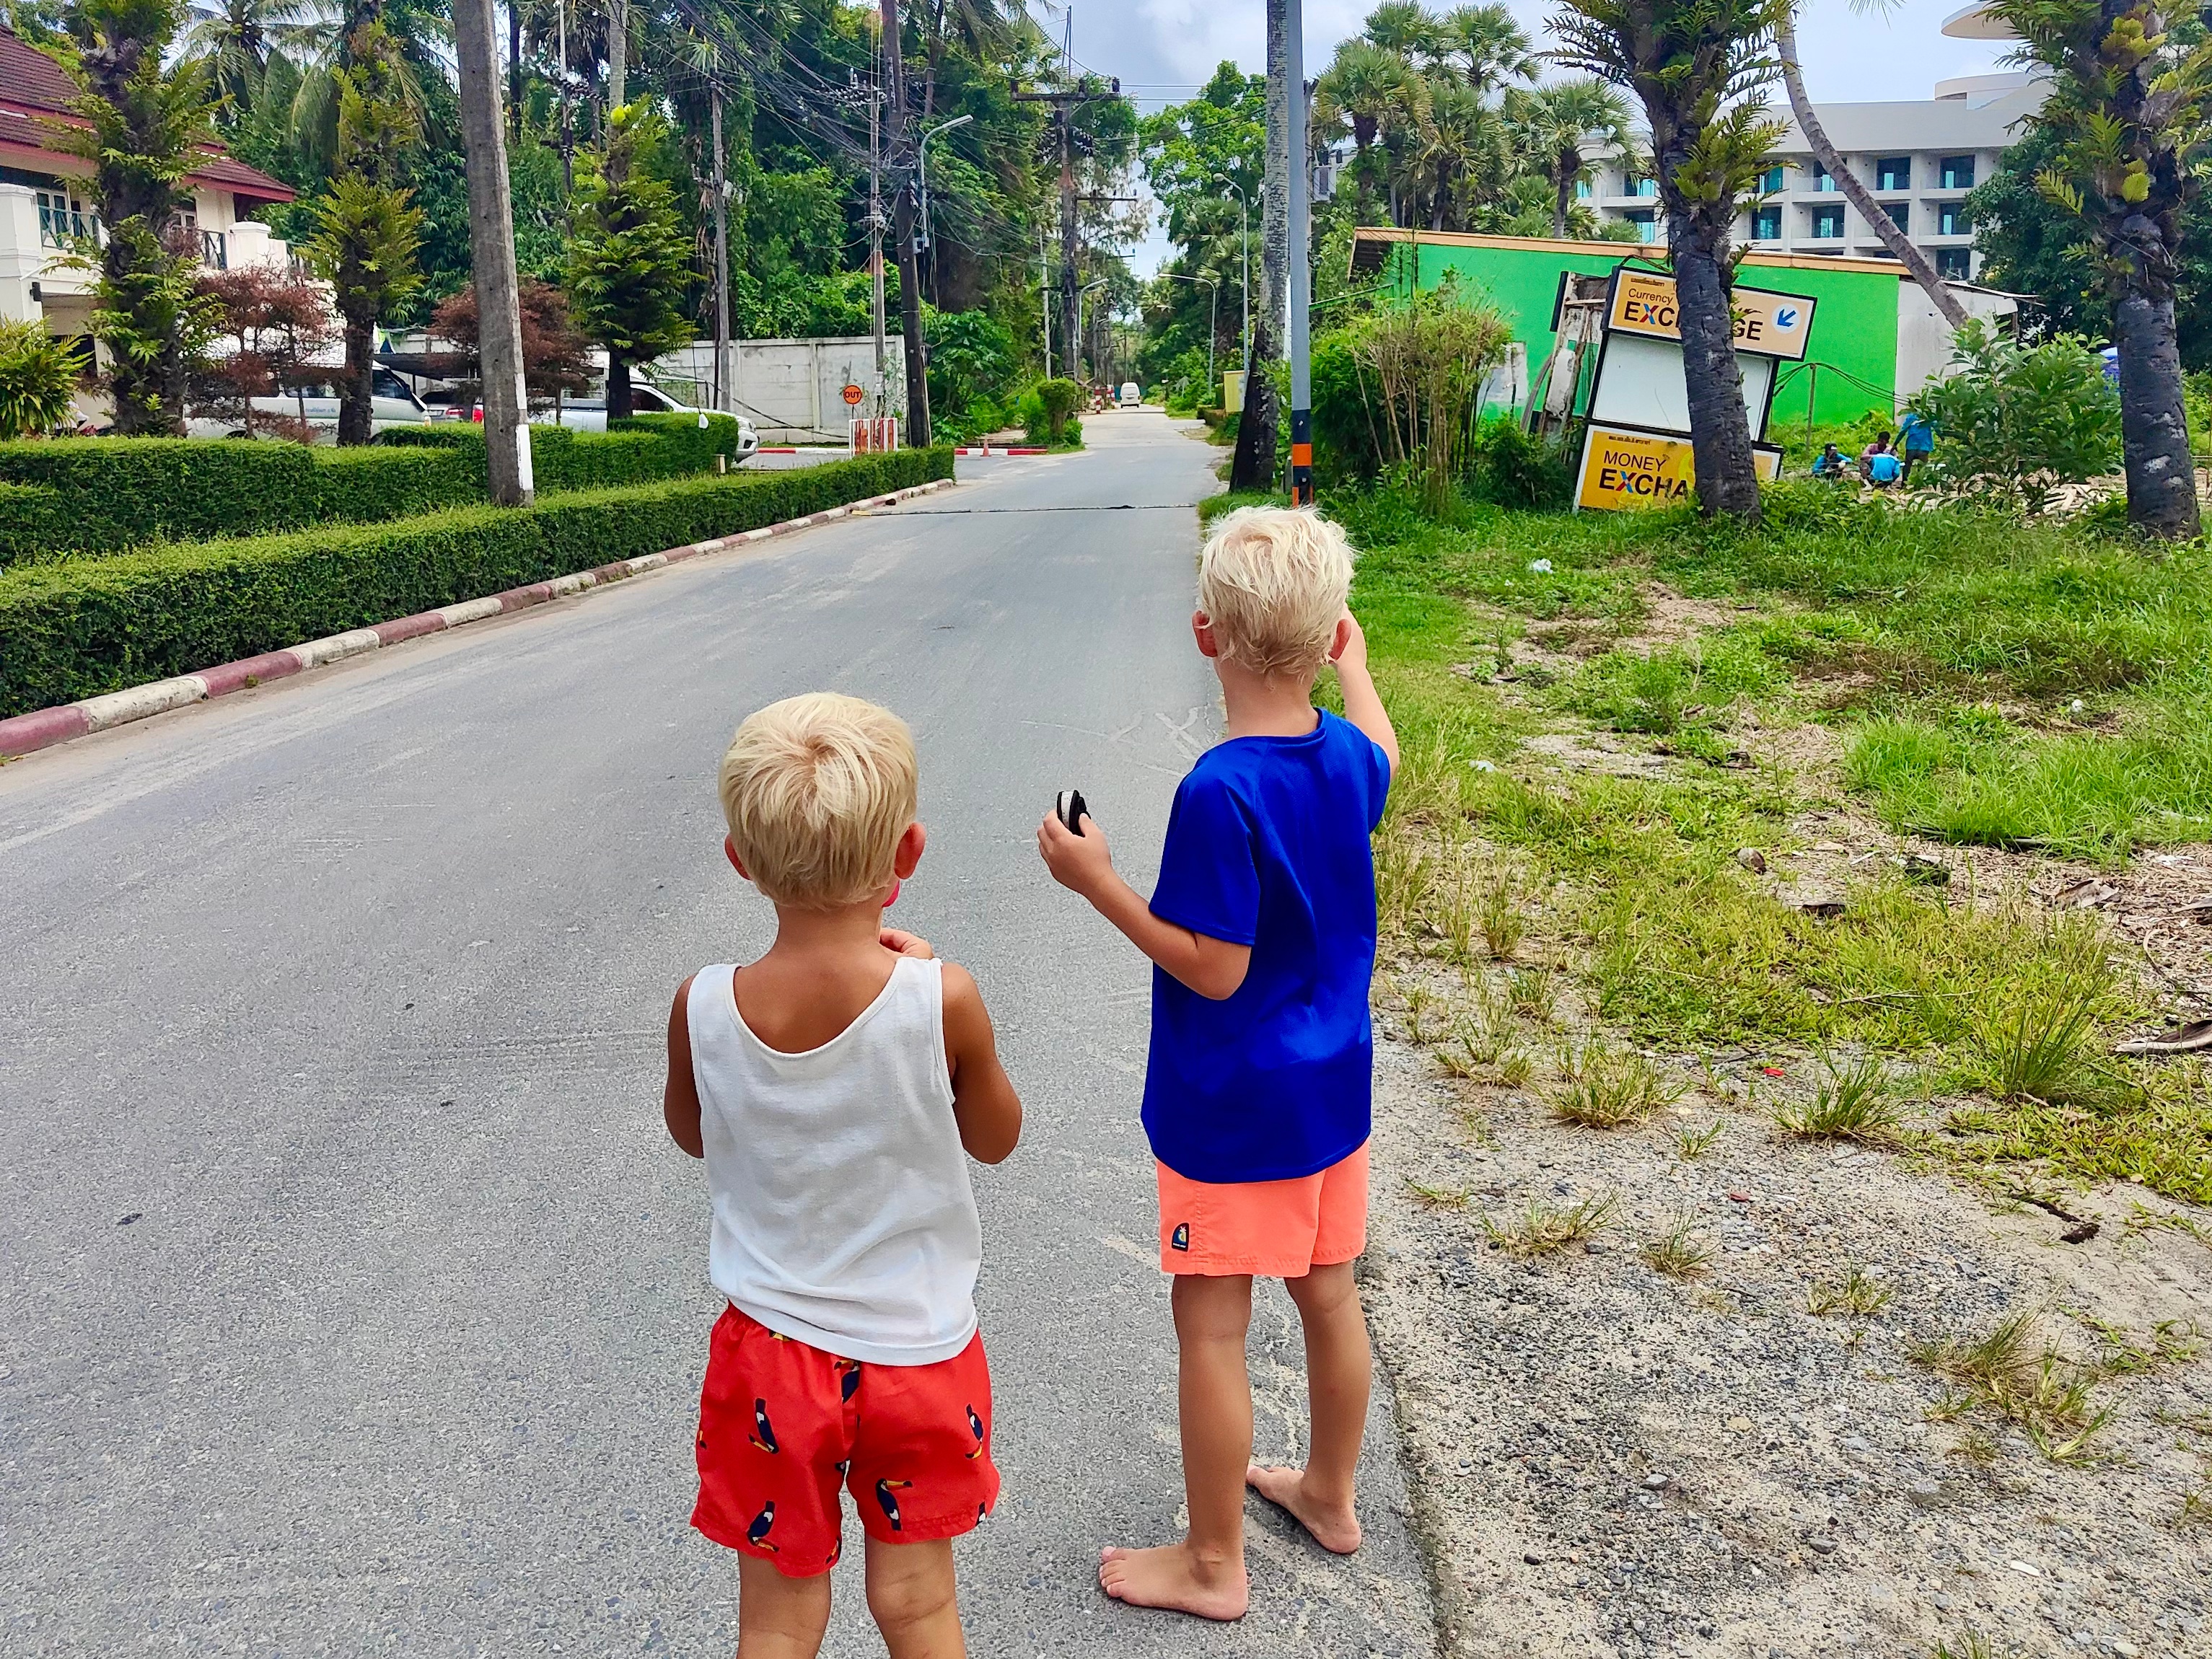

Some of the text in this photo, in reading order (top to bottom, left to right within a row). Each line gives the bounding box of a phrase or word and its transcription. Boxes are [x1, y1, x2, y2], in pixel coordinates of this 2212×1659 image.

[1628, 288, 1673, 306] Currency
[1624, 301, 1763, 340] EXCGE
[1604, 450, 1667, 472] MONEY
[1599, 467, 1689, 500] EXCHA
